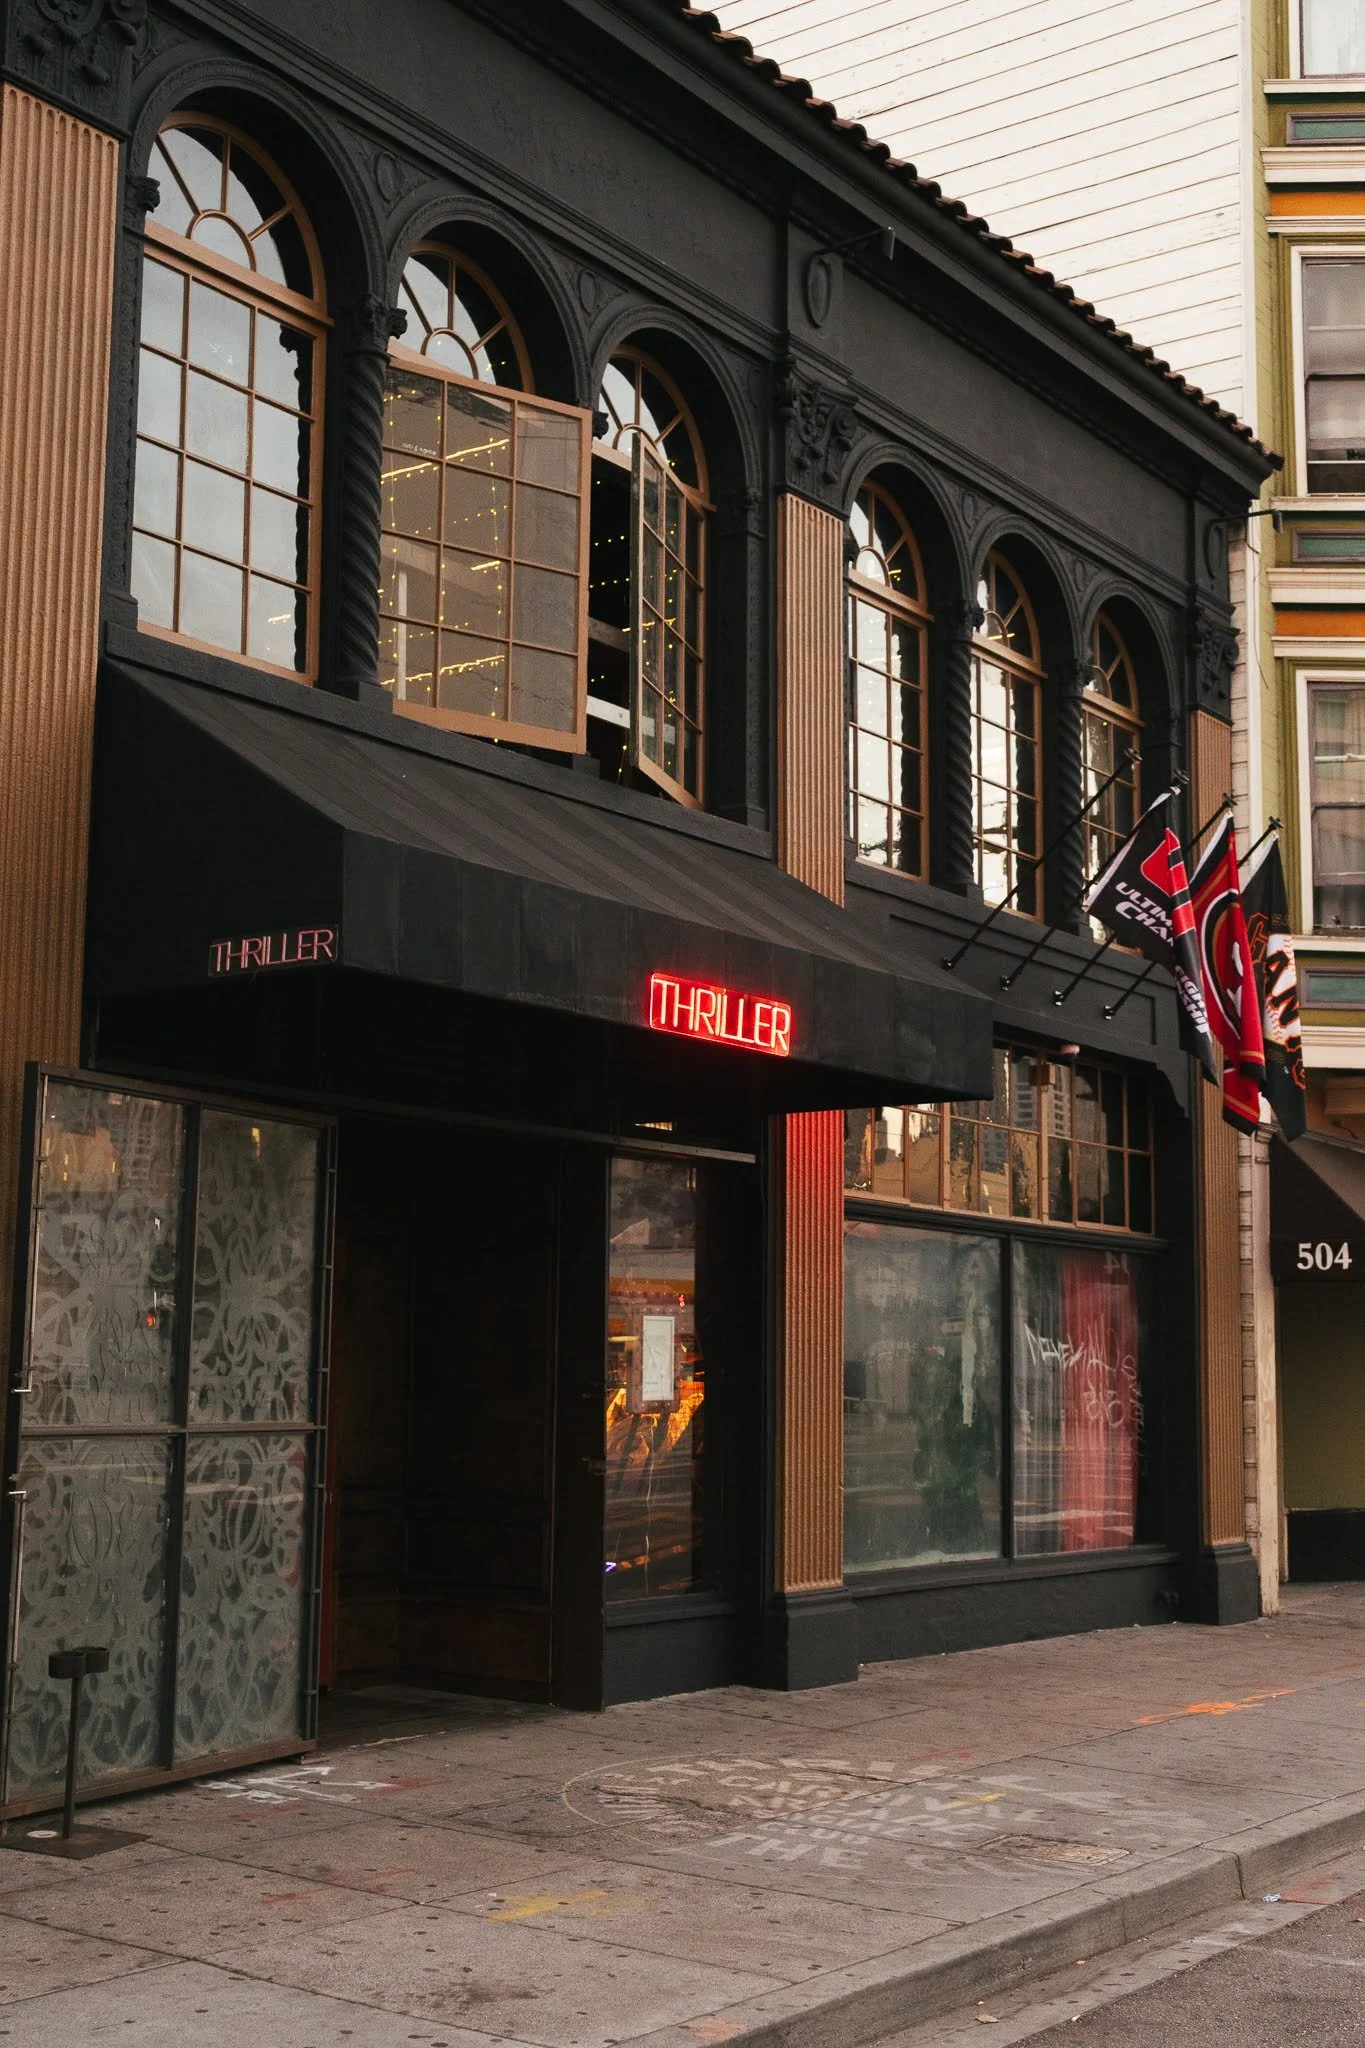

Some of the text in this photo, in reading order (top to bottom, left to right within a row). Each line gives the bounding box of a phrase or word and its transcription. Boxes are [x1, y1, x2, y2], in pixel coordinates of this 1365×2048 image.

[1116, 881, 1173, 931] ULTIM
[211, 929, 334, 973] THRILLER
[652, 978, 791, 1052] THRILLER
[1296, 1242, 1353, 1271] 504
